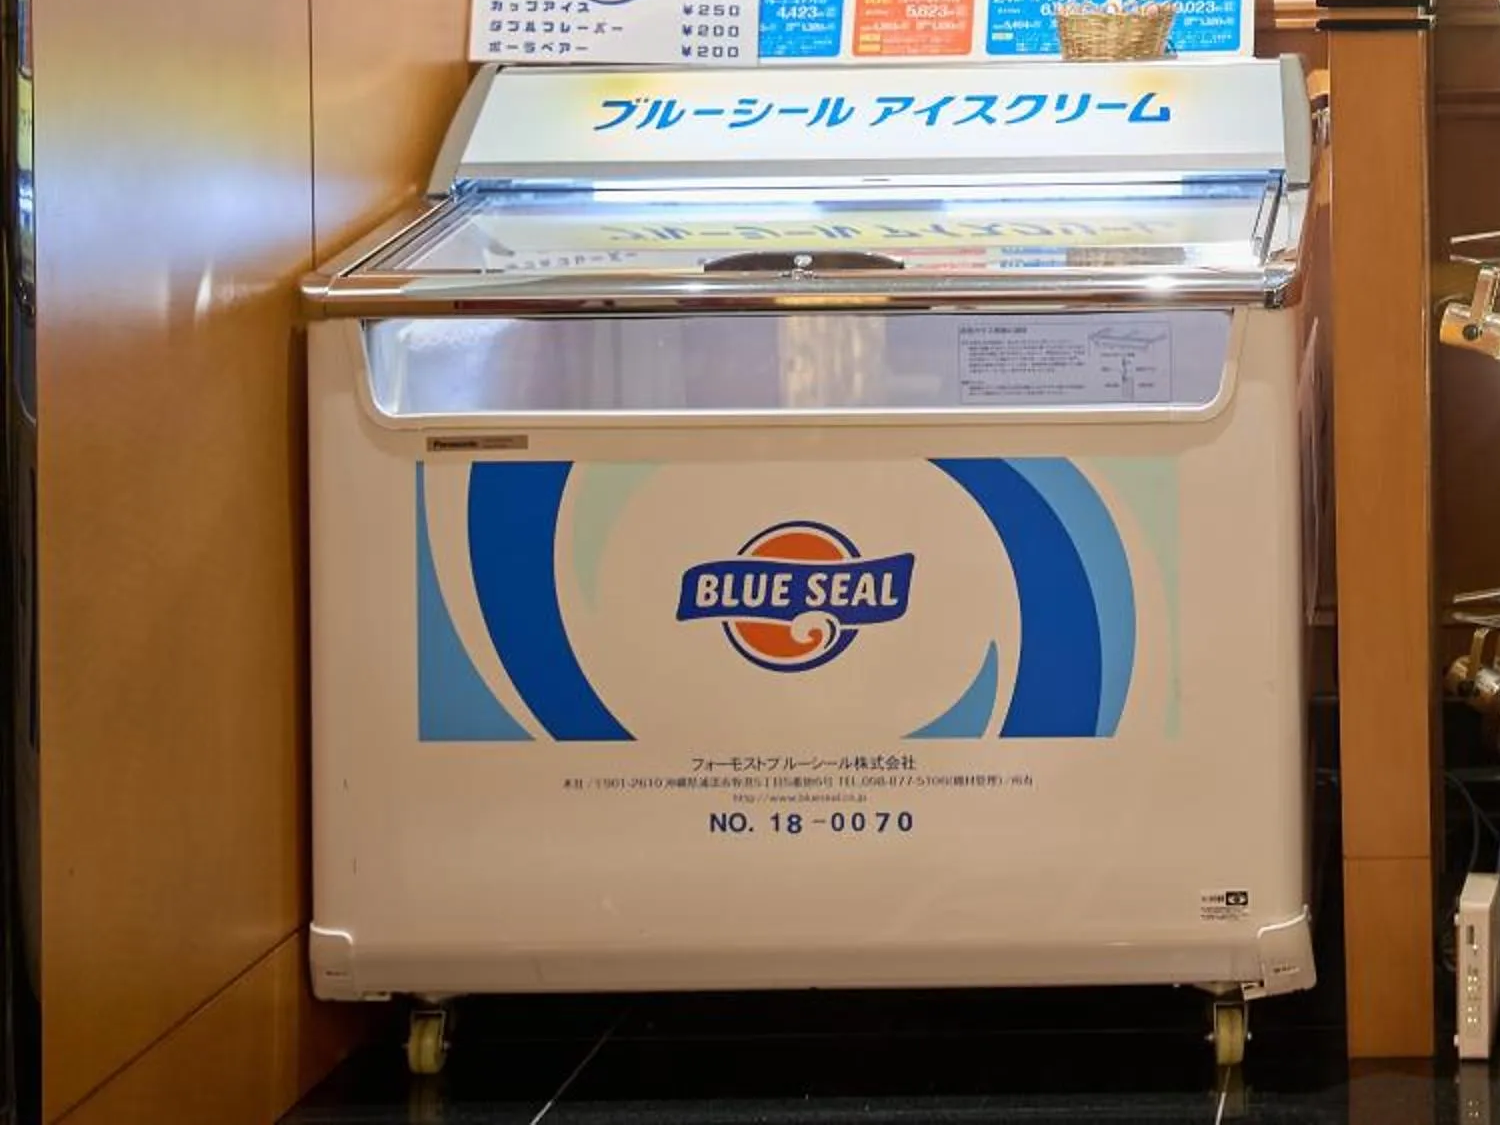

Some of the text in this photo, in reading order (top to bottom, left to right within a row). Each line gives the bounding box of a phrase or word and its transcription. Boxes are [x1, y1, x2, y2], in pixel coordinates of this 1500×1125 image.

[592, 92, 1172, 132] ブルーシール アイスクリーム
[695, 571, 899, 608] BLUE SEAL
[709, 812, 755, 833] NO.
